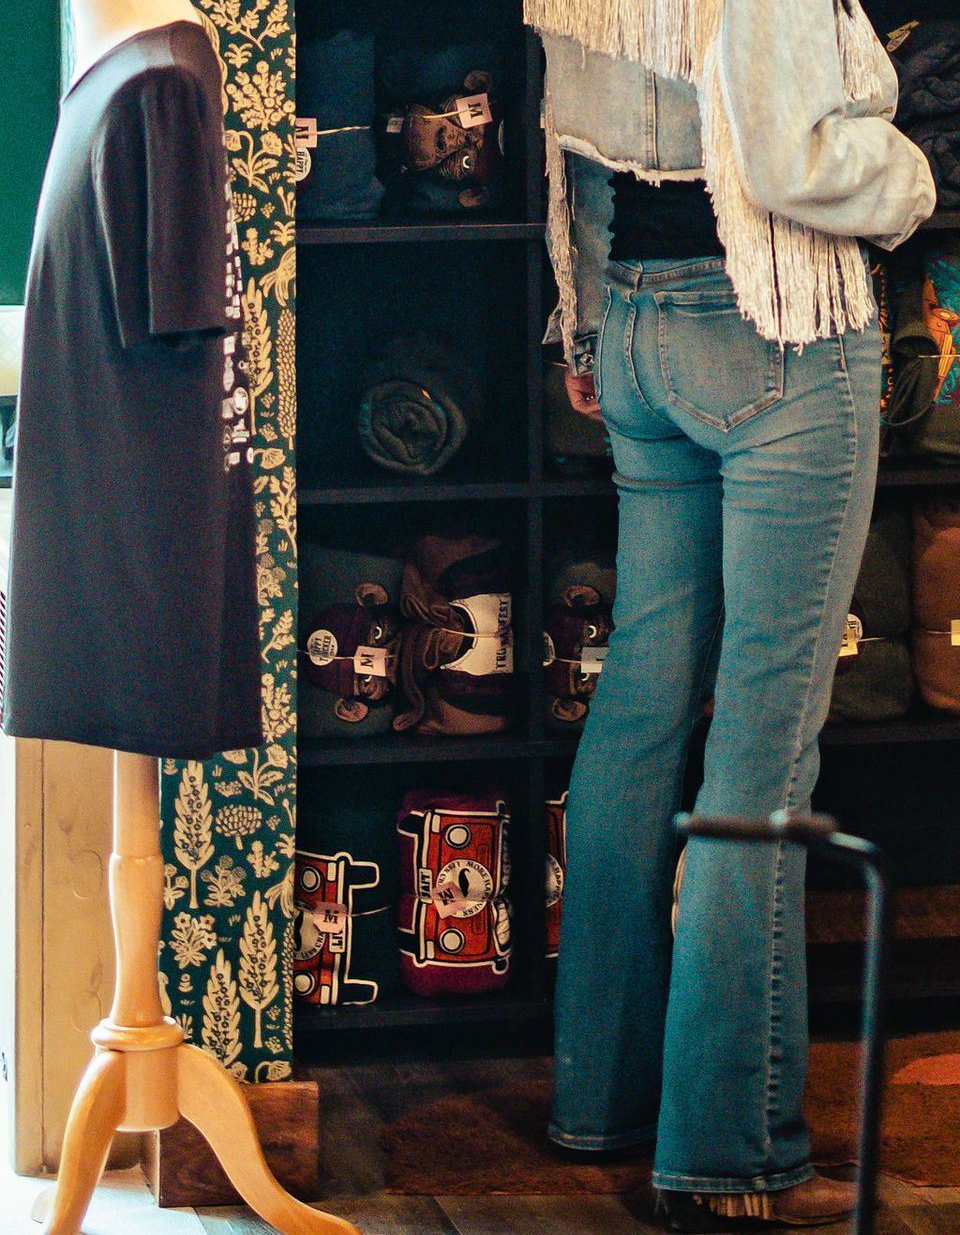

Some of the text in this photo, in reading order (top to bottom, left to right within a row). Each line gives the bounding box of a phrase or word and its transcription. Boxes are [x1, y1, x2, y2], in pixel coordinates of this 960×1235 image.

[468, 101, 485, 119] M
[360, 653, 375, 669] M
[437, 887, 456, 906] M
